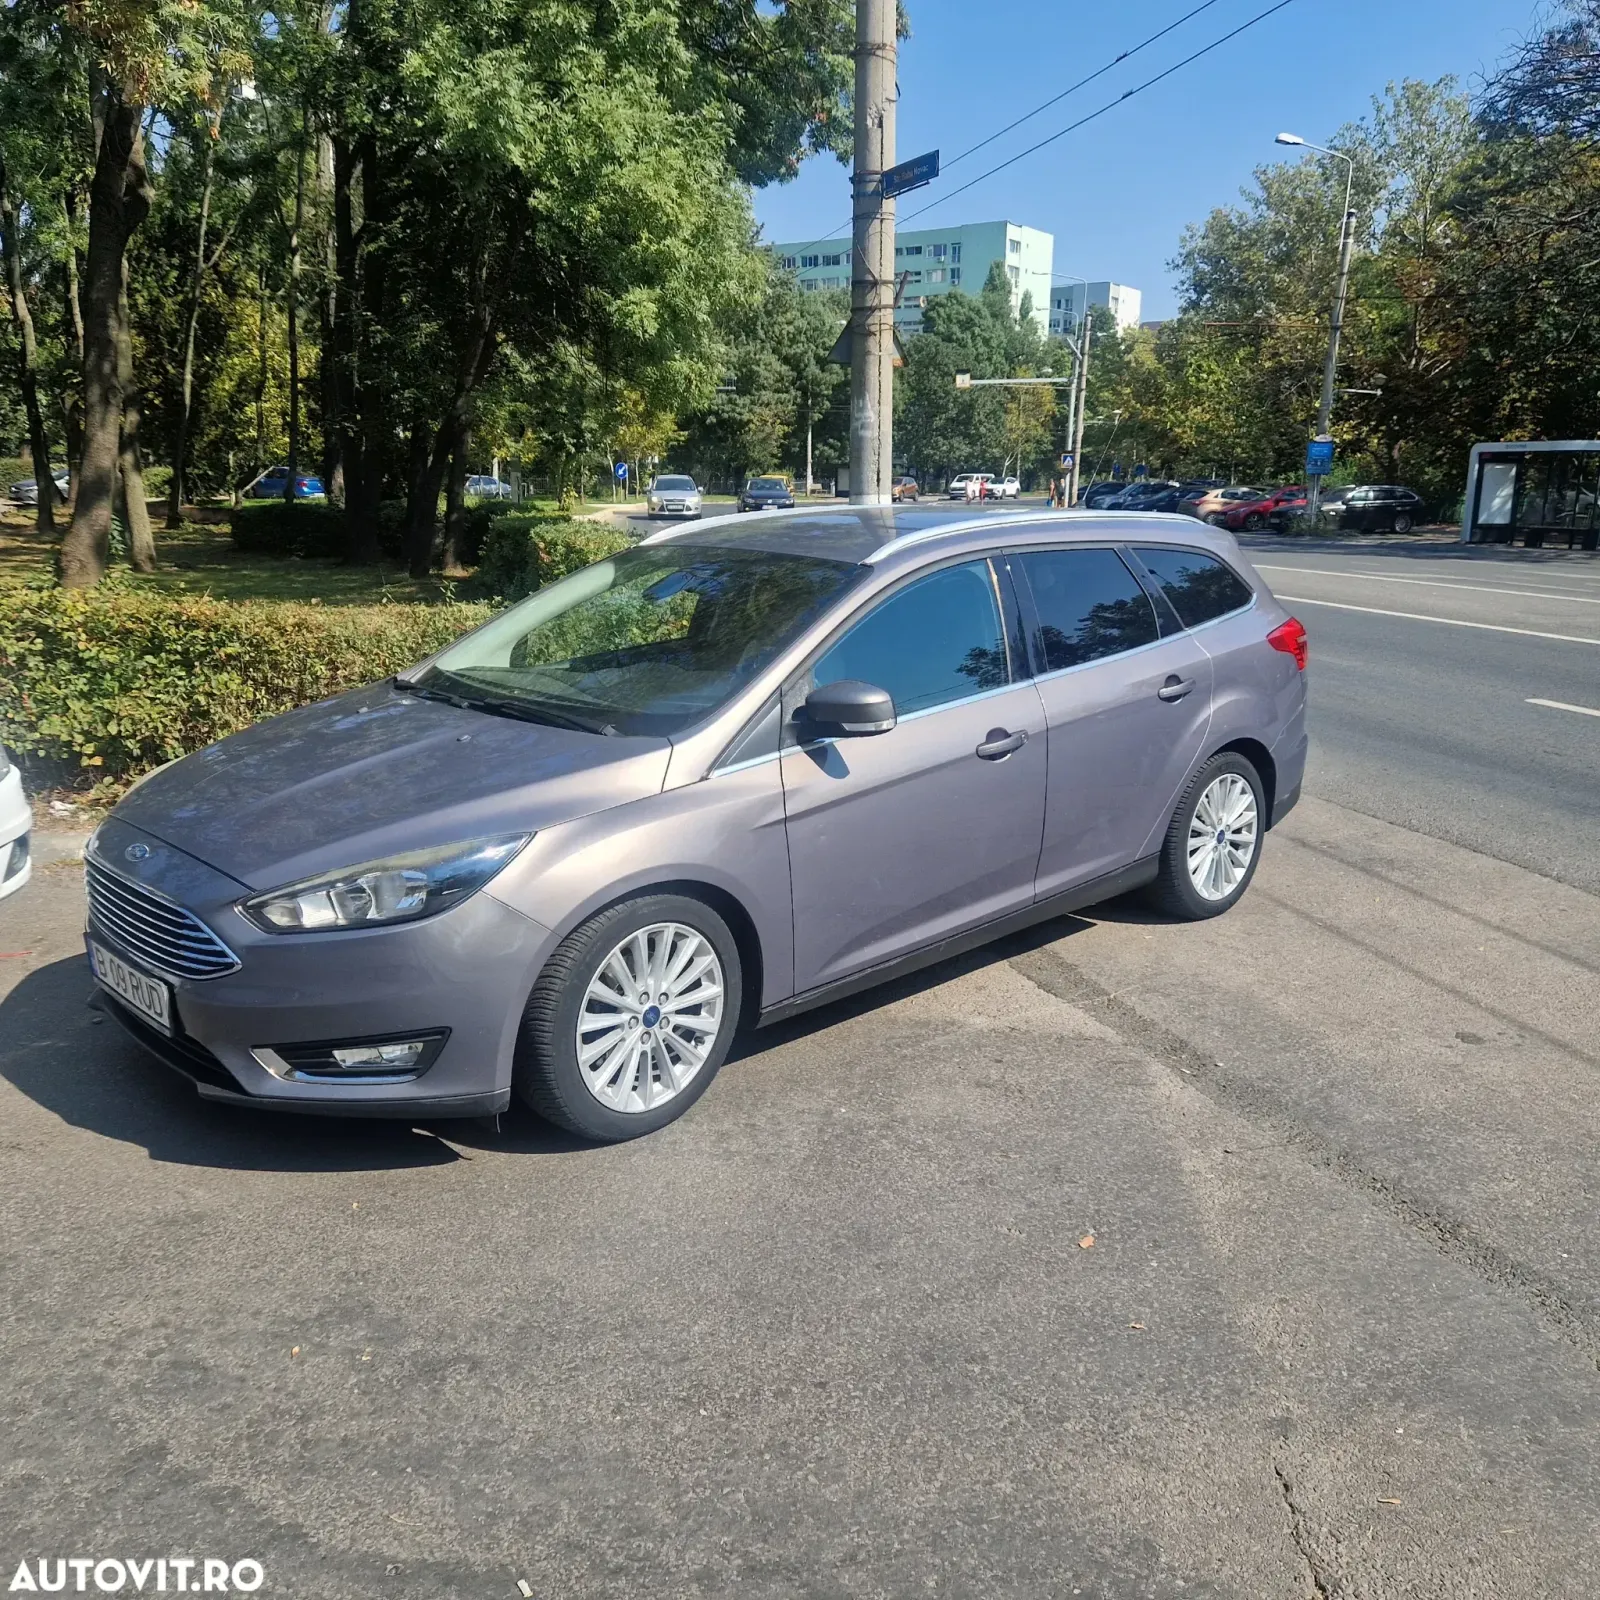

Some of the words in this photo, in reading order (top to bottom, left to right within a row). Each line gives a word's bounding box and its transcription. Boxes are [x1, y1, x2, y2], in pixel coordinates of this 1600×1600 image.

[95, 946, 107, 977] B
[110, 958, 127, 994] 09
[128, 970, 163, 1018] RUD
